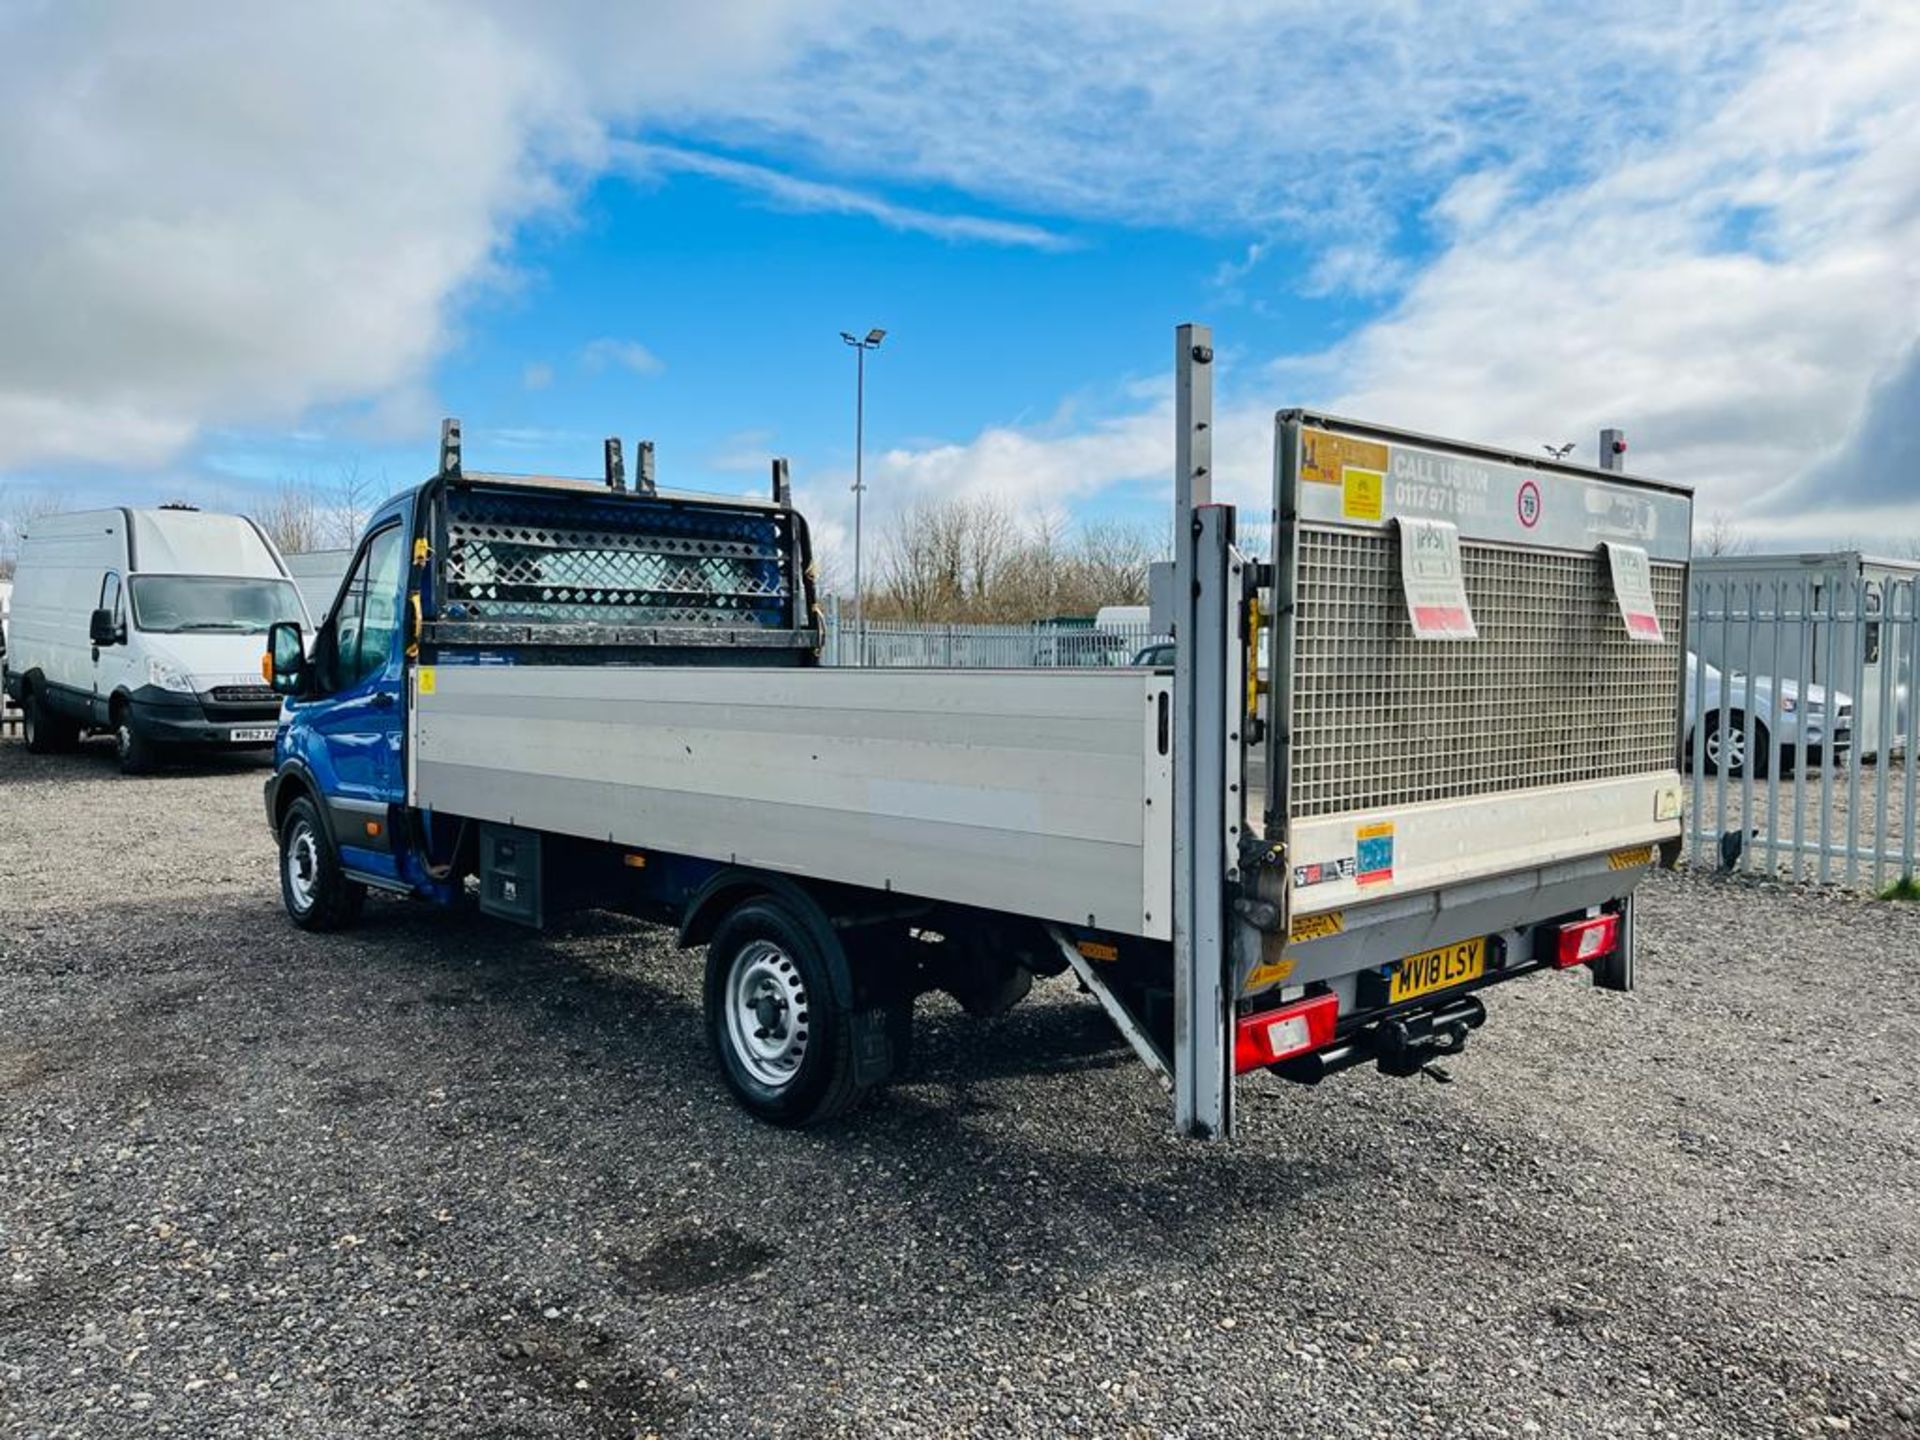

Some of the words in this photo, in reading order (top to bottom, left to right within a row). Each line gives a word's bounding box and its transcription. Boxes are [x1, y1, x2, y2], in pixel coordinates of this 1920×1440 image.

[1394, 454, 1435, 483] CALL
[1440, 463, 1463, 489] US
[1395, 482, 1427, 508] 0117
[1399, 954, 1441, 994] MV18
[1445, 941, 1479, 980] LSY
